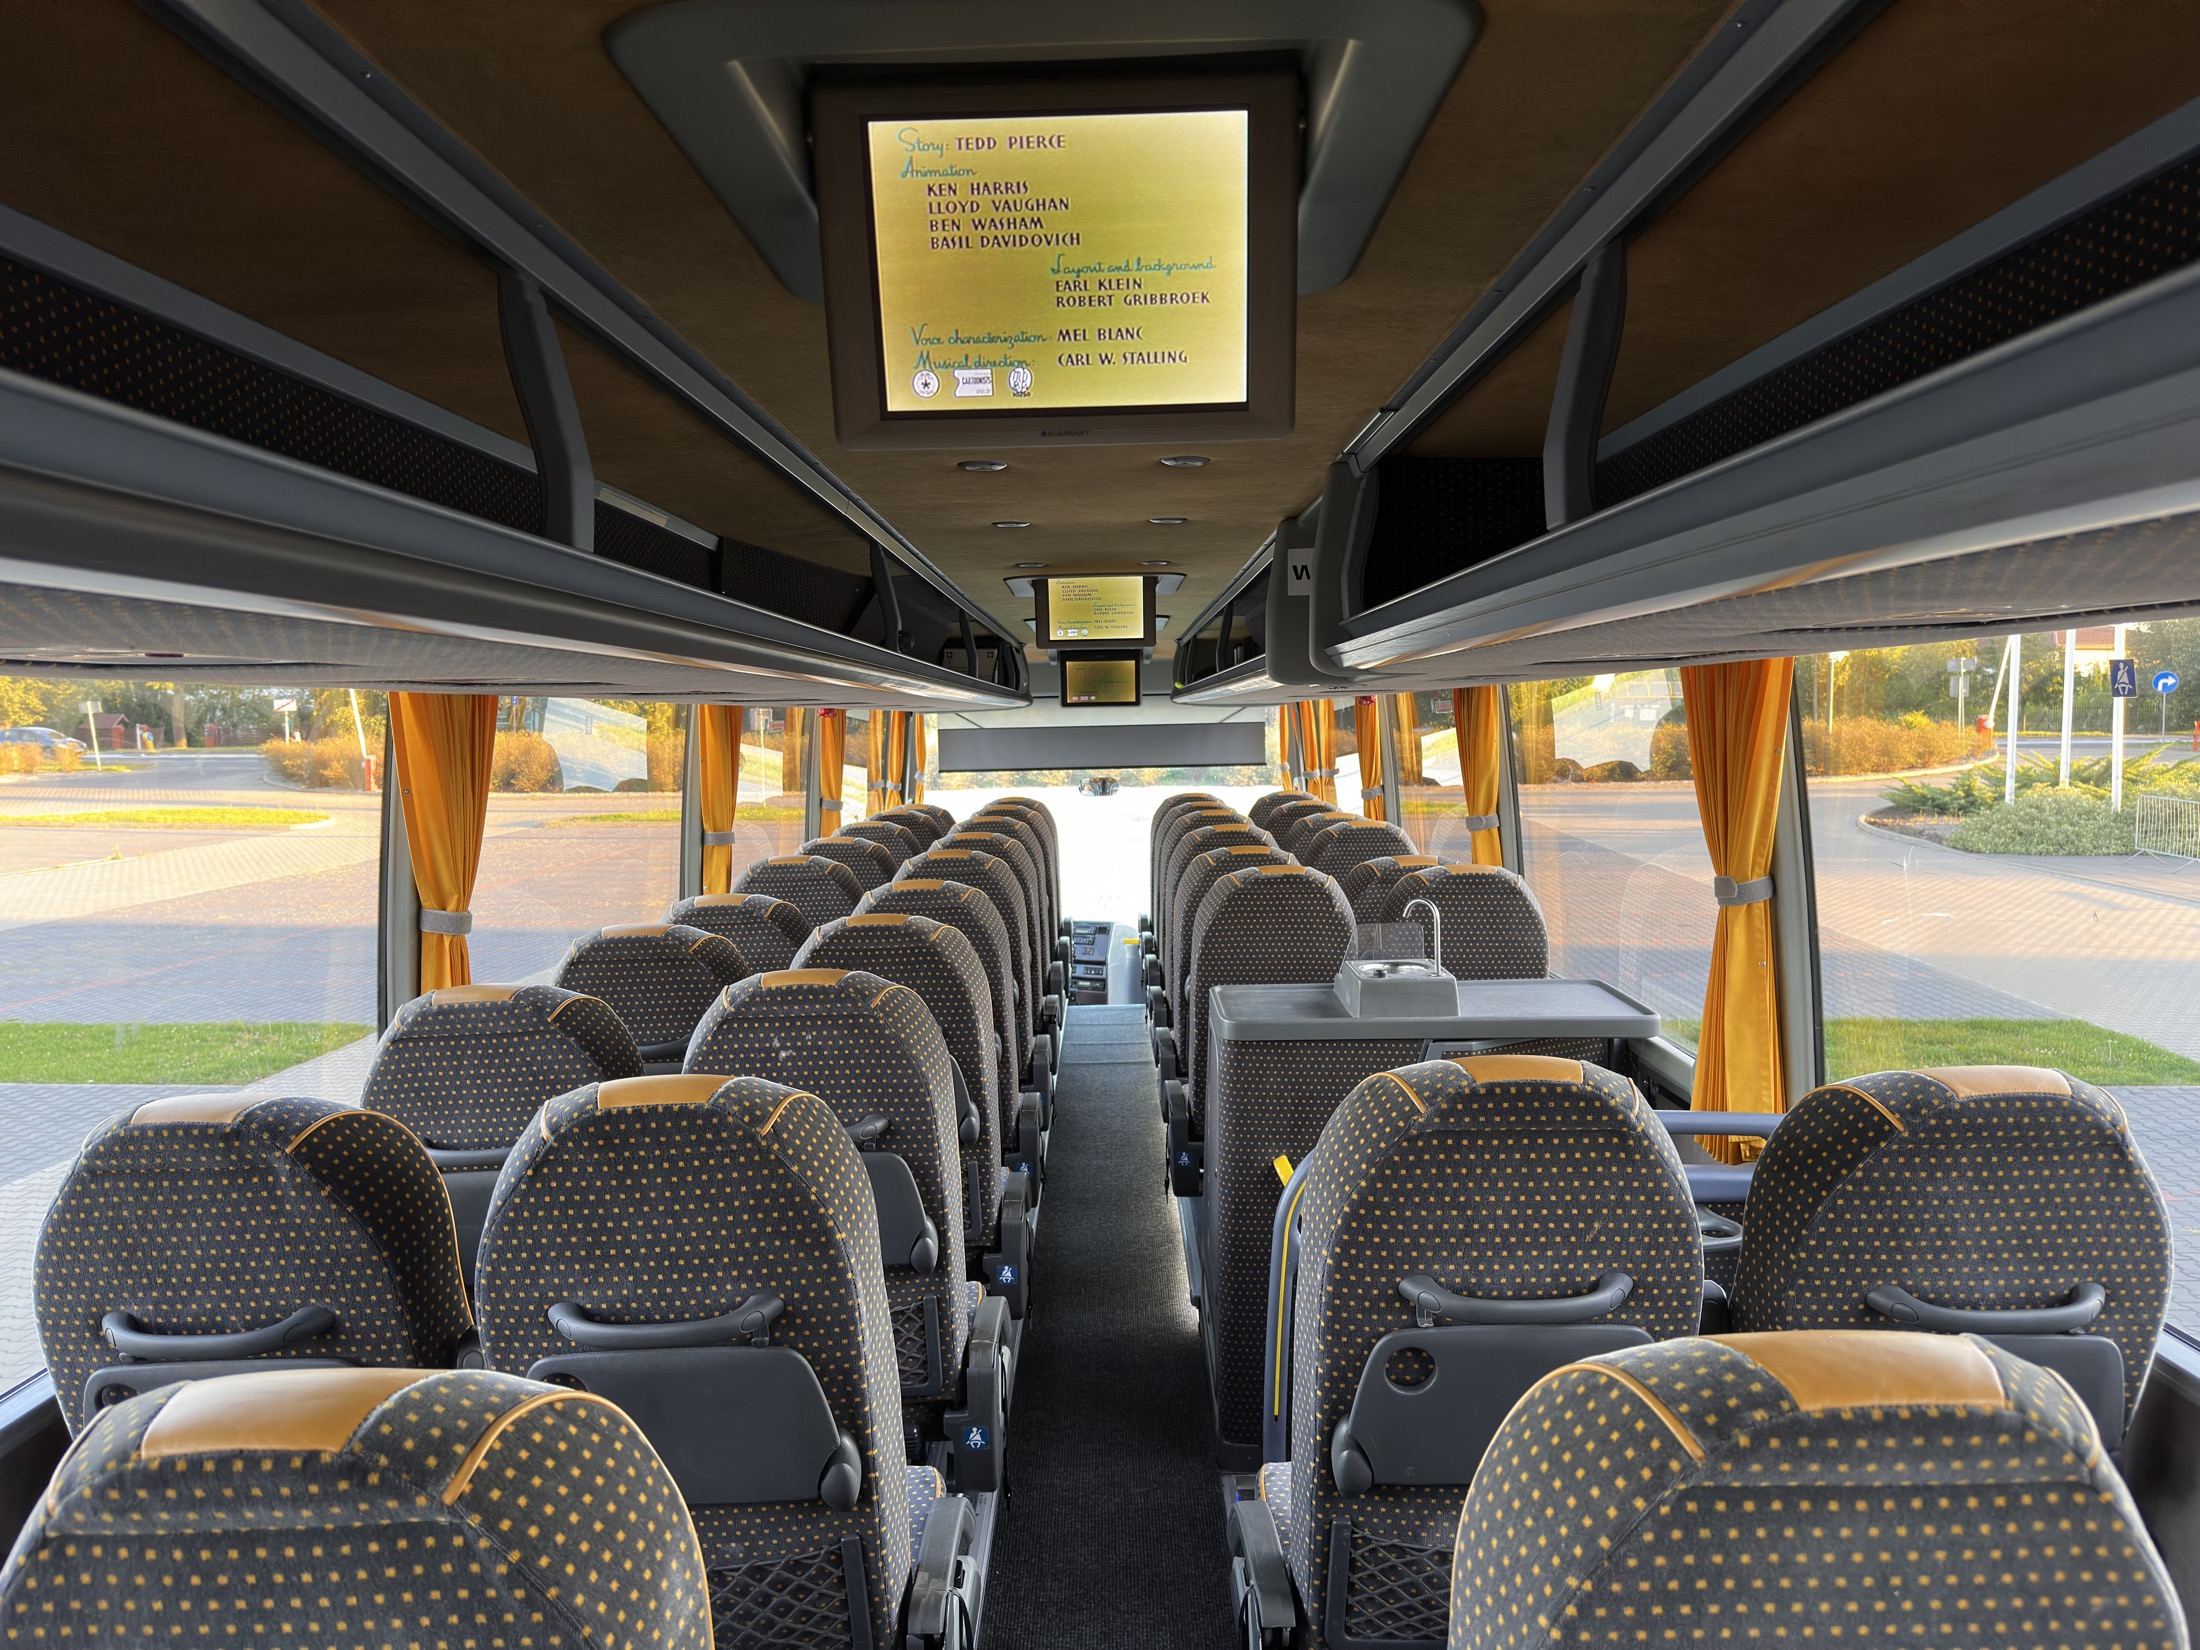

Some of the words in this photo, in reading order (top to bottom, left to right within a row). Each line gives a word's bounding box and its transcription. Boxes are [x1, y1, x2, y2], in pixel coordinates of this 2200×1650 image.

[897, 127, 949, 158] Story:
[956, 137, 997, 150] TEDD
[1009, 134, 1066, 149] PIERCE
[900, 156, 977, 178] Animation
[927, 183, 957, 197] KEN
[970, 180, 1029, 196] HARRIS
[928, 200, 980, 215] LLOYD
[991, 197, 1070, 212] VAUGHAN
[930, 219, 961, 232] BEN
[971, 216, 1044, 231] WASHAM
[931, 235, 973, 250] BASIL
[980, 232, 1081, 249] DAVIDOVICH
[1051, 253, 1104, 278] Layout
[1107, 258, 1132, 273] and
[1134, 255, 1216, 276] background
[1055, 279, 1090, 293] EARL
[1097, 277, 1143, 291] KLEIN
[1056, 294, 1114, 308] ROBERT
[1124, 291, 1211, 307] GRIBBROEK
[1057, 328, 1090, 342] MEL
[1098, 326, 1143, 341] BLANC
[913, 350, 969, 371] Musical
[1058, 352, 1092, 367] CARL
[1099, 352, 1116, 366] W.
[1122, 350, 1188, 366] STALLING
[1292, 564, 1312, 581] W
